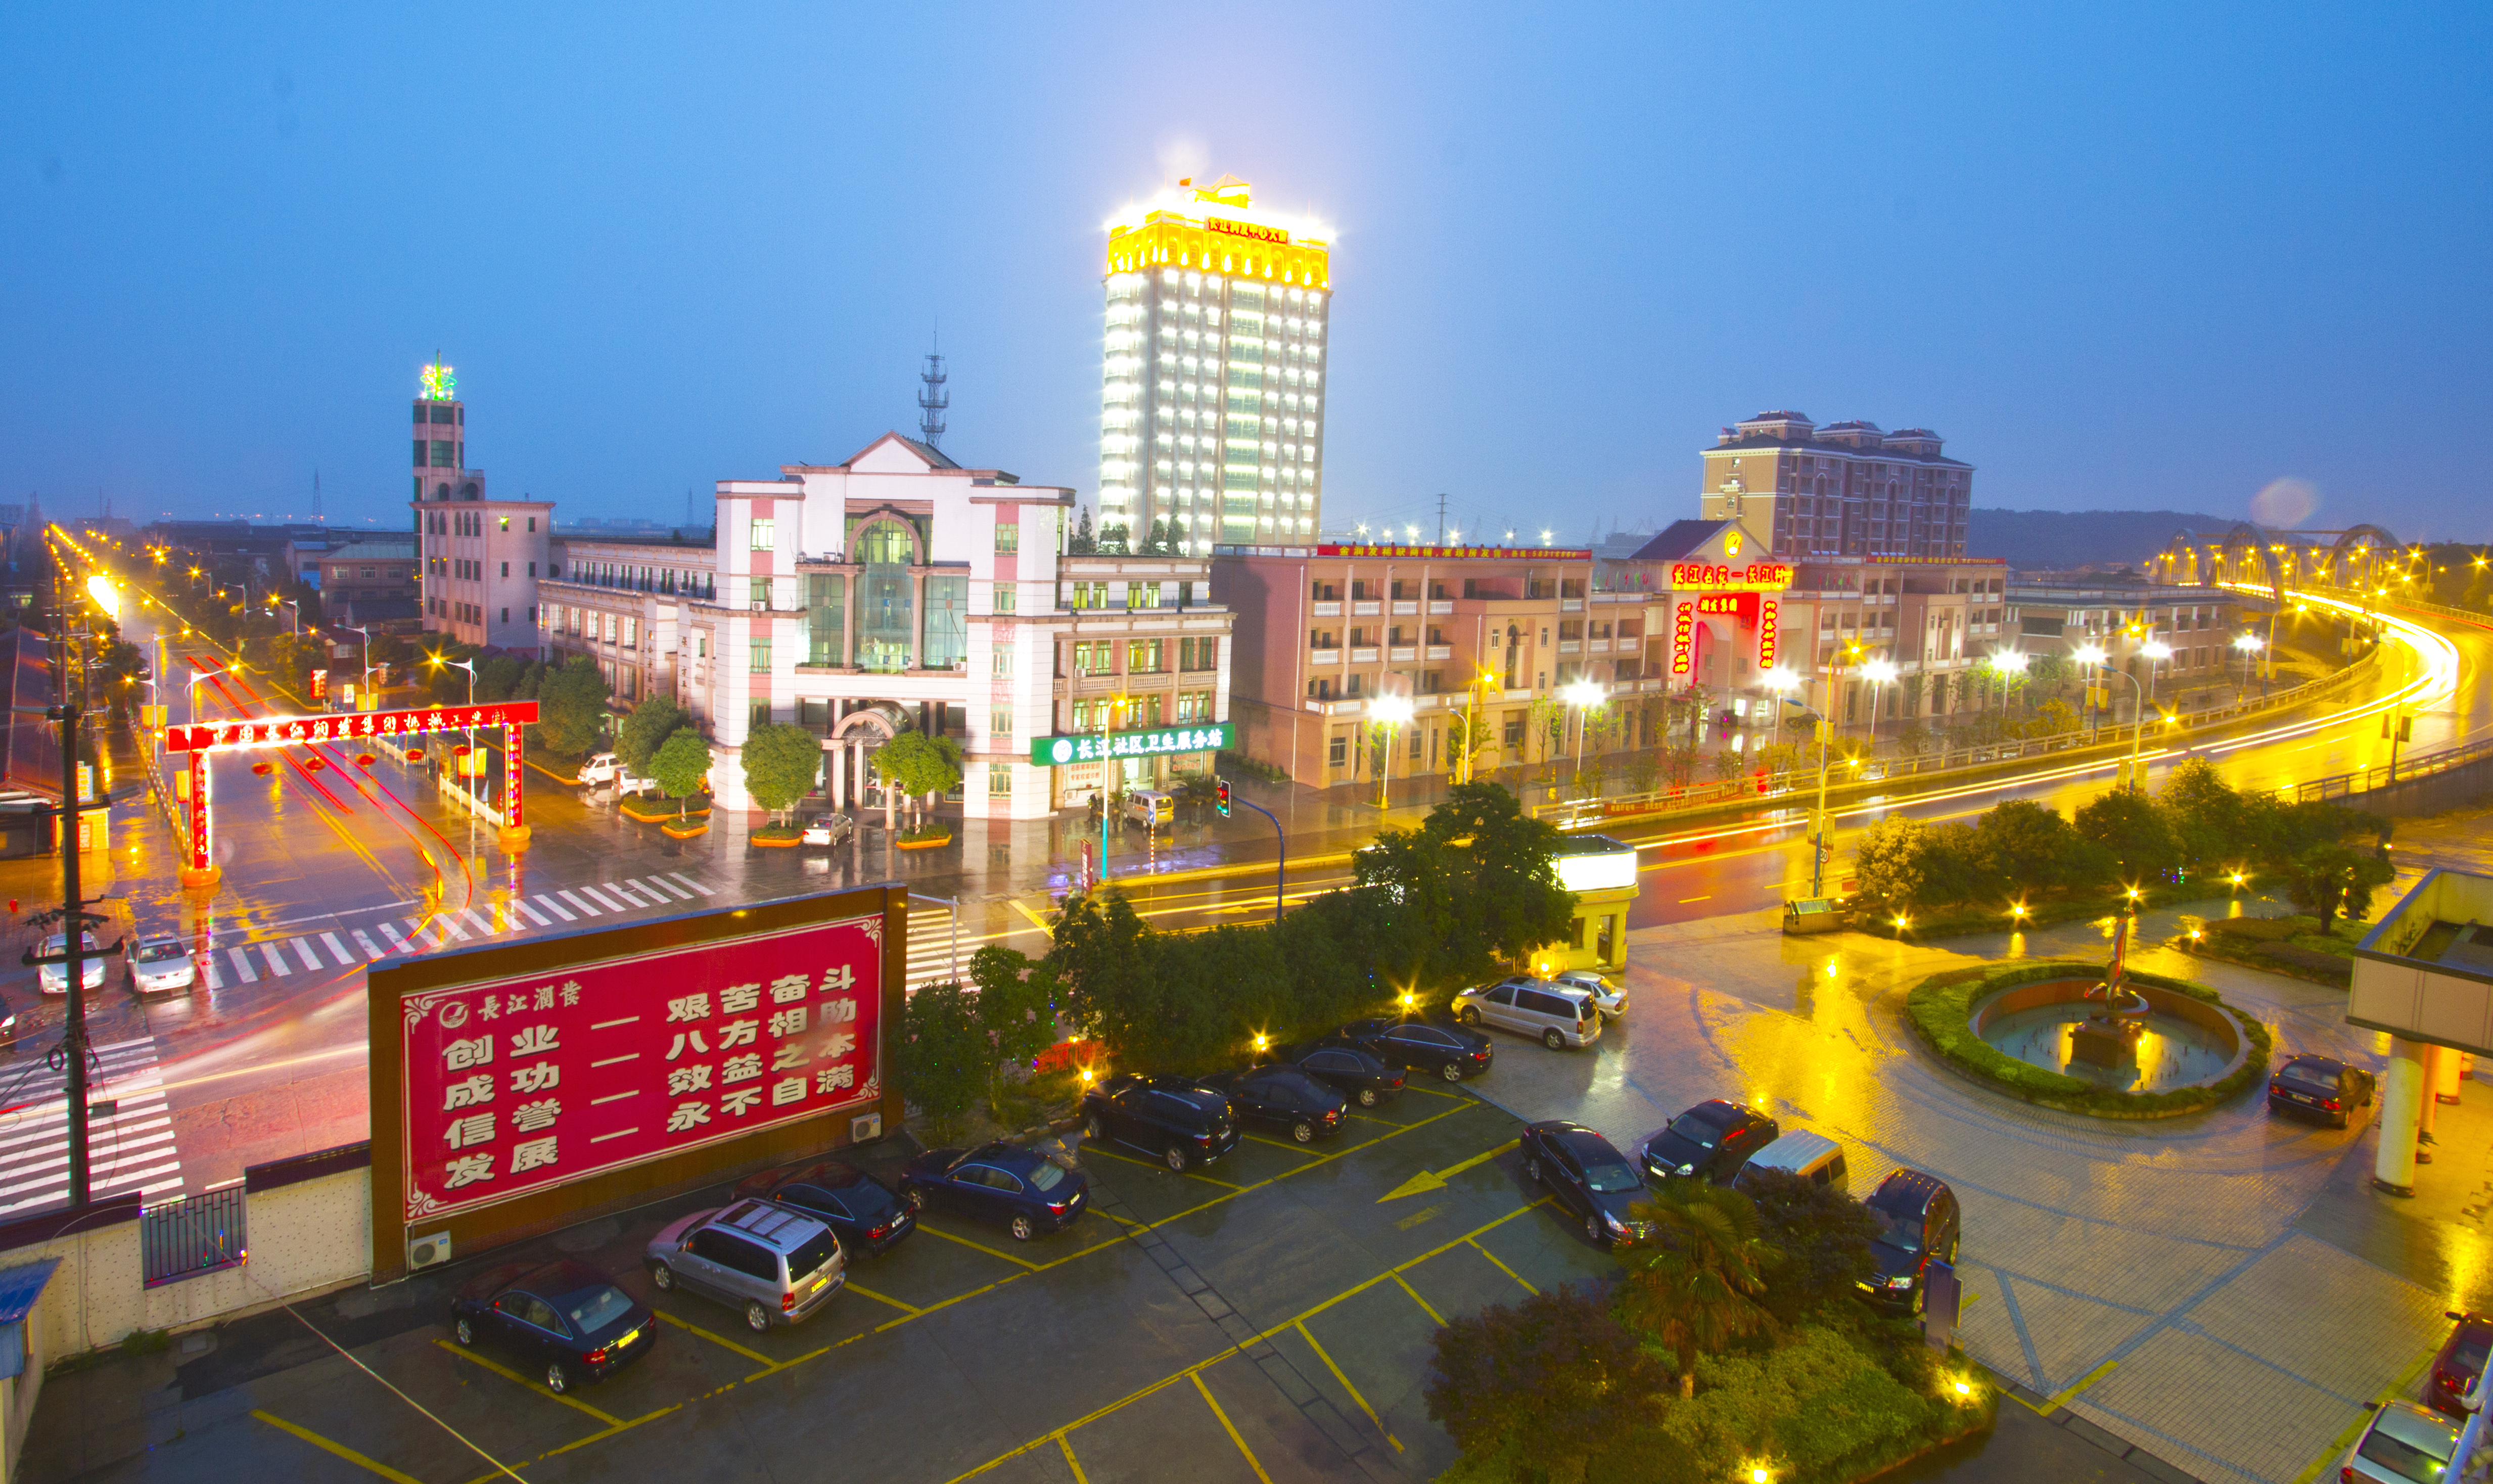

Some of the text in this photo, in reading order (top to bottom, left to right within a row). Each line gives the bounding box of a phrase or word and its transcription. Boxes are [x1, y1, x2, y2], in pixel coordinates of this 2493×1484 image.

[1077, 728, 1222, 759] 长江社区卫生服务站
